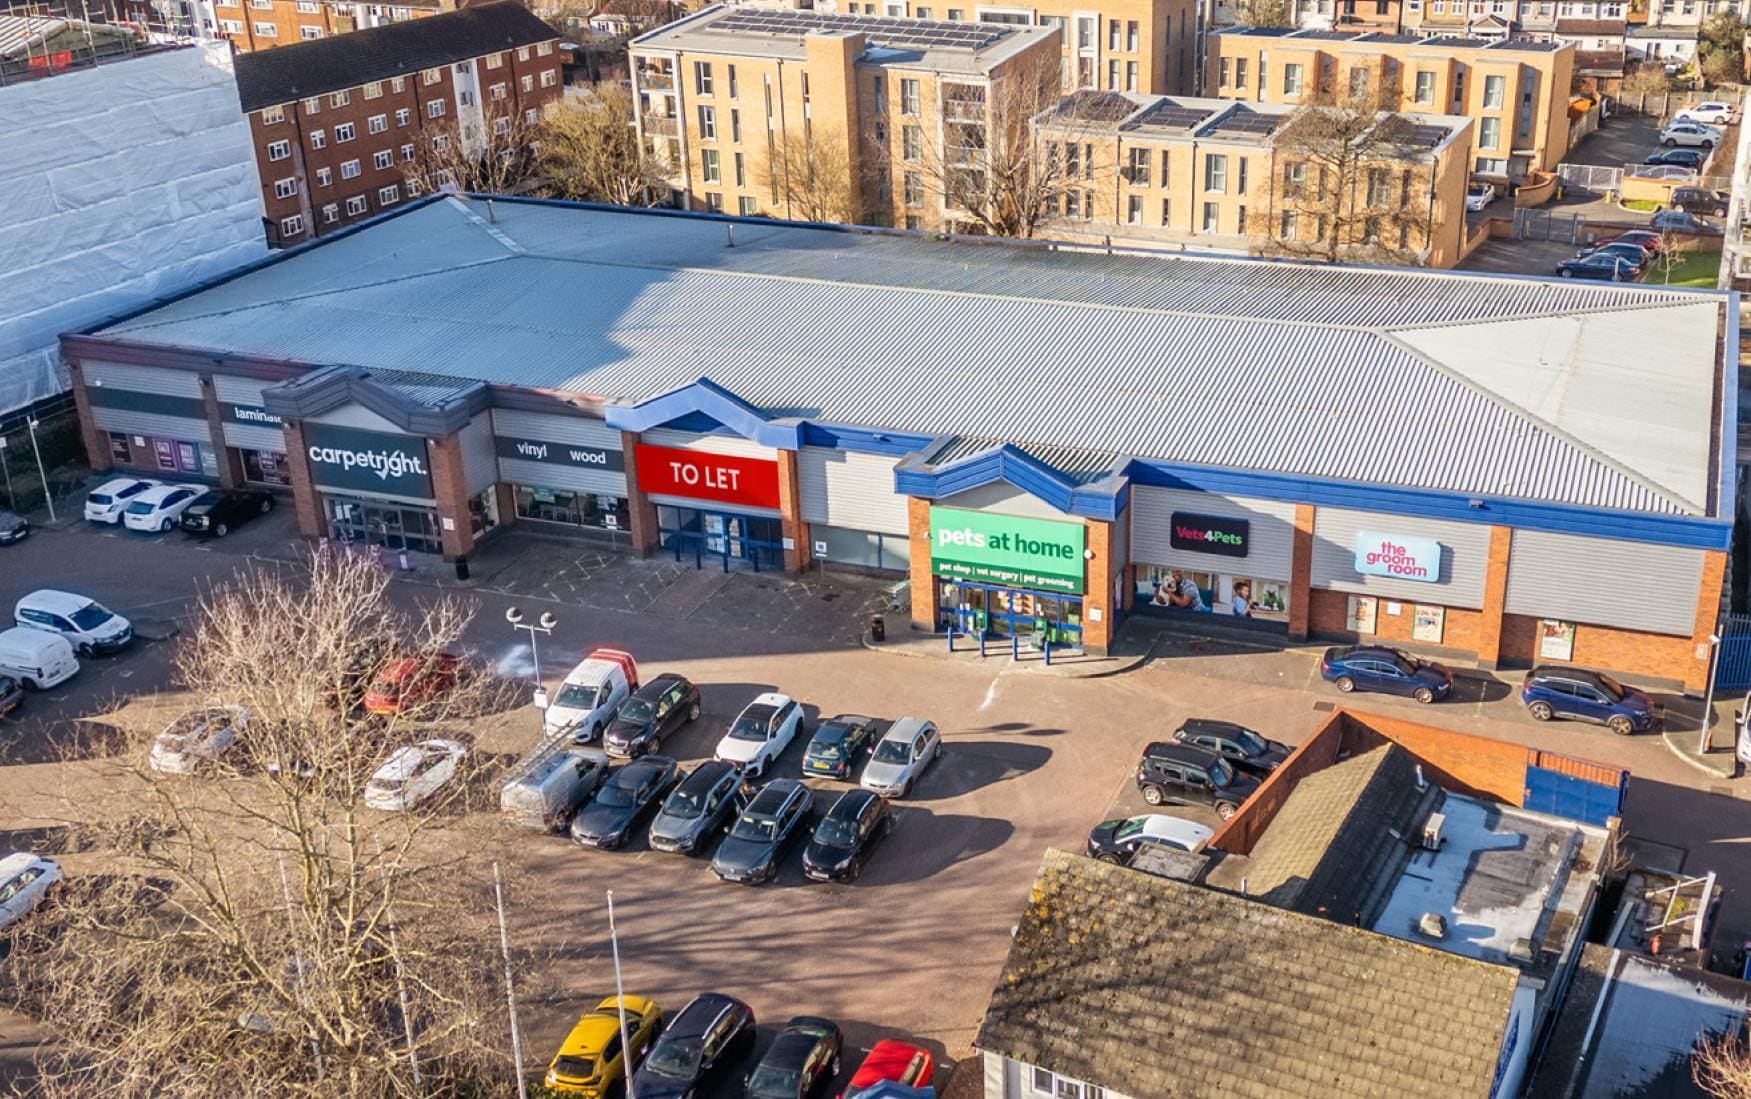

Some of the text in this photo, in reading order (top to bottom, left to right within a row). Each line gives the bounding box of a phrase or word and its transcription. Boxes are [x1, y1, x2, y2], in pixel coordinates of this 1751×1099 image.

[517, 441, 606, 464] vinyl wood
[670, 461, 740, 491] TO LET
[938, 528, 1074, 559] pets at home
[1176, 526, 1243, 545] Vets4Pets
[1366, 552, 1416, 566] groom
[1381, 541, 1406, 556] the
[939, 563, 1074, 589] pet shop vet surgery pet grooming
[1387, 564, 1427, 577] room
